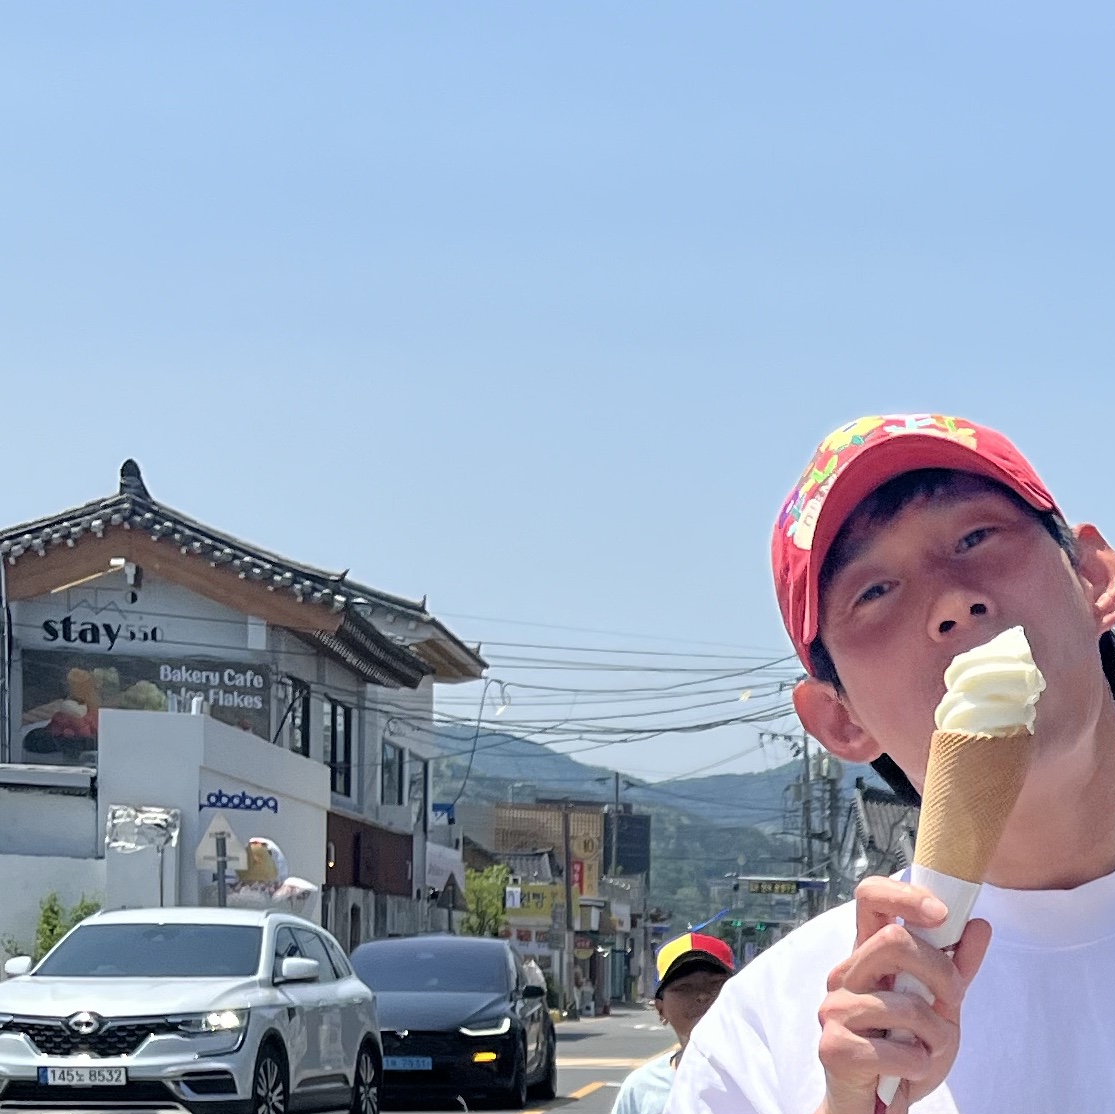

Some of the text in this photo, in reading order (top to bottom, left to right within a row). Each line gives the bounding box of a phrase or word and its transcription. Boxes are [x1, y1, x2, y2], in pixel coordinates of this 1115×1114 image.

[160, 664, 264, 688] Bakery Cafe
[209, 688, 263, 709] Flakes
[88, 1069, 122, 1083] 8532
